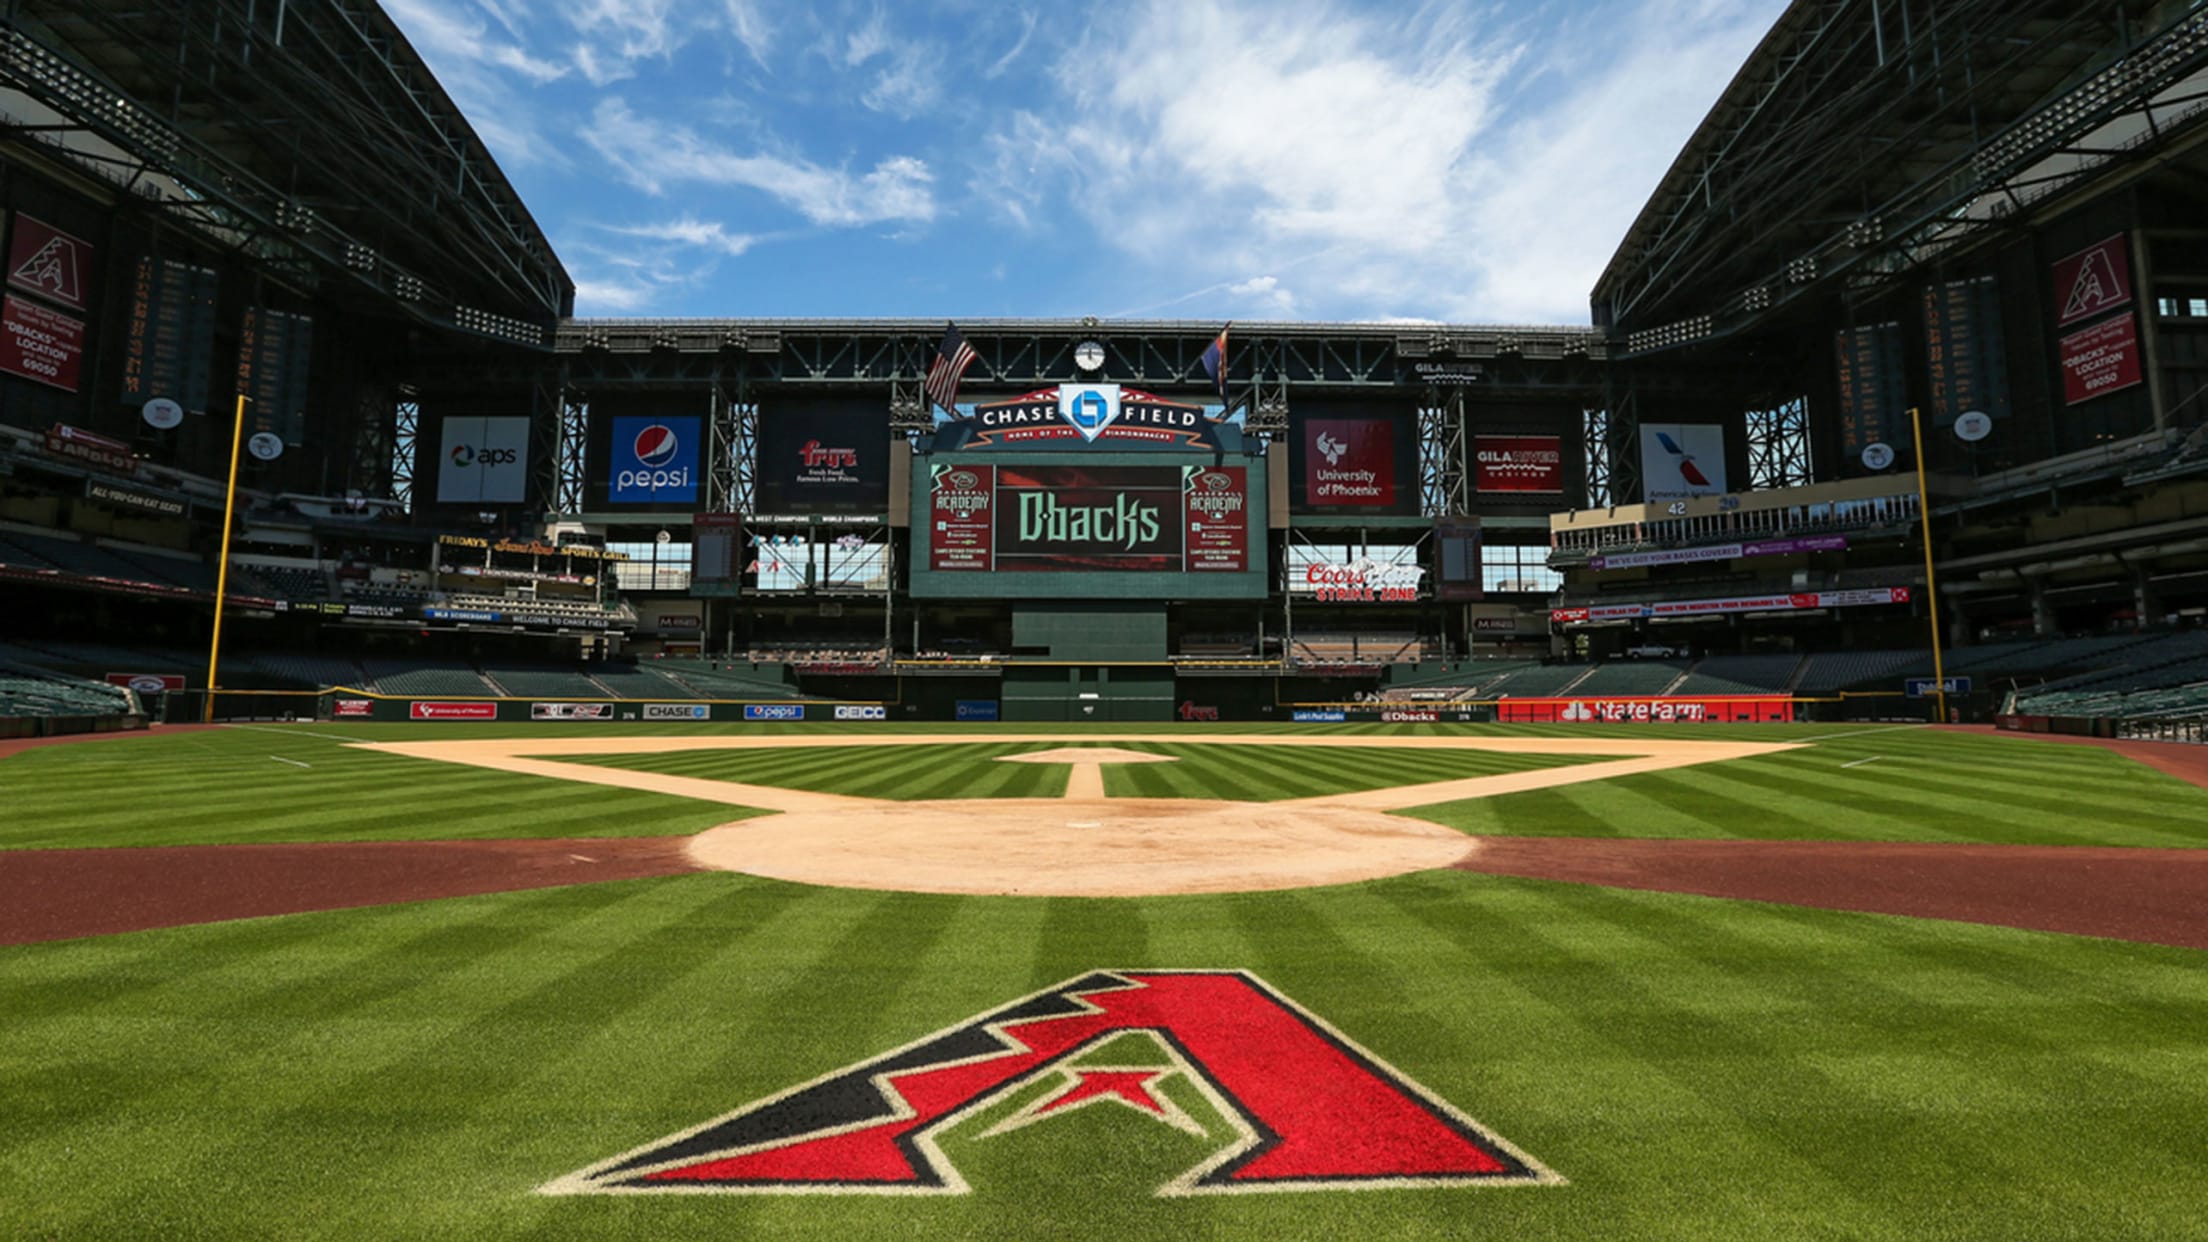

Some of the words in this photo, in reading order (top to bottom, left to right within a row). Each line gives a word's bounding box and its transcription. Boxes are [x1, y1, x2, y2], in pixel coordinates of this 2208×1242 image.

[16, 335, 68, 361] LOCATION
[23, 357, 58, 377] 69050
[2075, 351, 2124, 376] LOCATION
[983, 406, 1055, 425] CHASE
[1125, 406, 1197, 426] FIELD
[1007, 431, 1034, 440] HOME
[1038, 430, 1051, 438] OF
[1056, 429, 1074, 437] THE
[1104, 429, 1171, 441] DIAMONDBACKS
[48, 437, 136, 470] SANDLOT
[478, 448, 517, 468] aps
[617, 465, 689, 493] pepsi
[1316, 468, 1377, 484] University
[1317, 483, 1331, 496] of
[1332, 483, 1381, 497] Phoenix
[158, 500, 184, 514] SEATS
[935, 494, 989, 515] ACADEMY
[1189, 496, 1243, 516] ACADEMY
[1668, 501, 1687, 515] 42
[561, 546, 600, 560] SPORTS
[602, 551, 630, 562] GRILL
[1700, 546, 1740, 558] COVERED
[1305, 561, 1365, 585] Coors
[1315, 586, 1375, 602] STRIKE
[1380, 586, 1418, 602] ZONE
[512, 614, 549, 626] WELCOME
[551, 616, 562, 626] TO
[563, 618, 587, 629] CHASE
[588, 619, 610, 630] FIELD
[649, 706, 692, 717] CHASE
[764, 705, 796, 720] pepsi
[835, 706, 886, 719] GEICO
[1595, 700, 1648, 720] State
[1650, 701, 1706, 720] Farm
